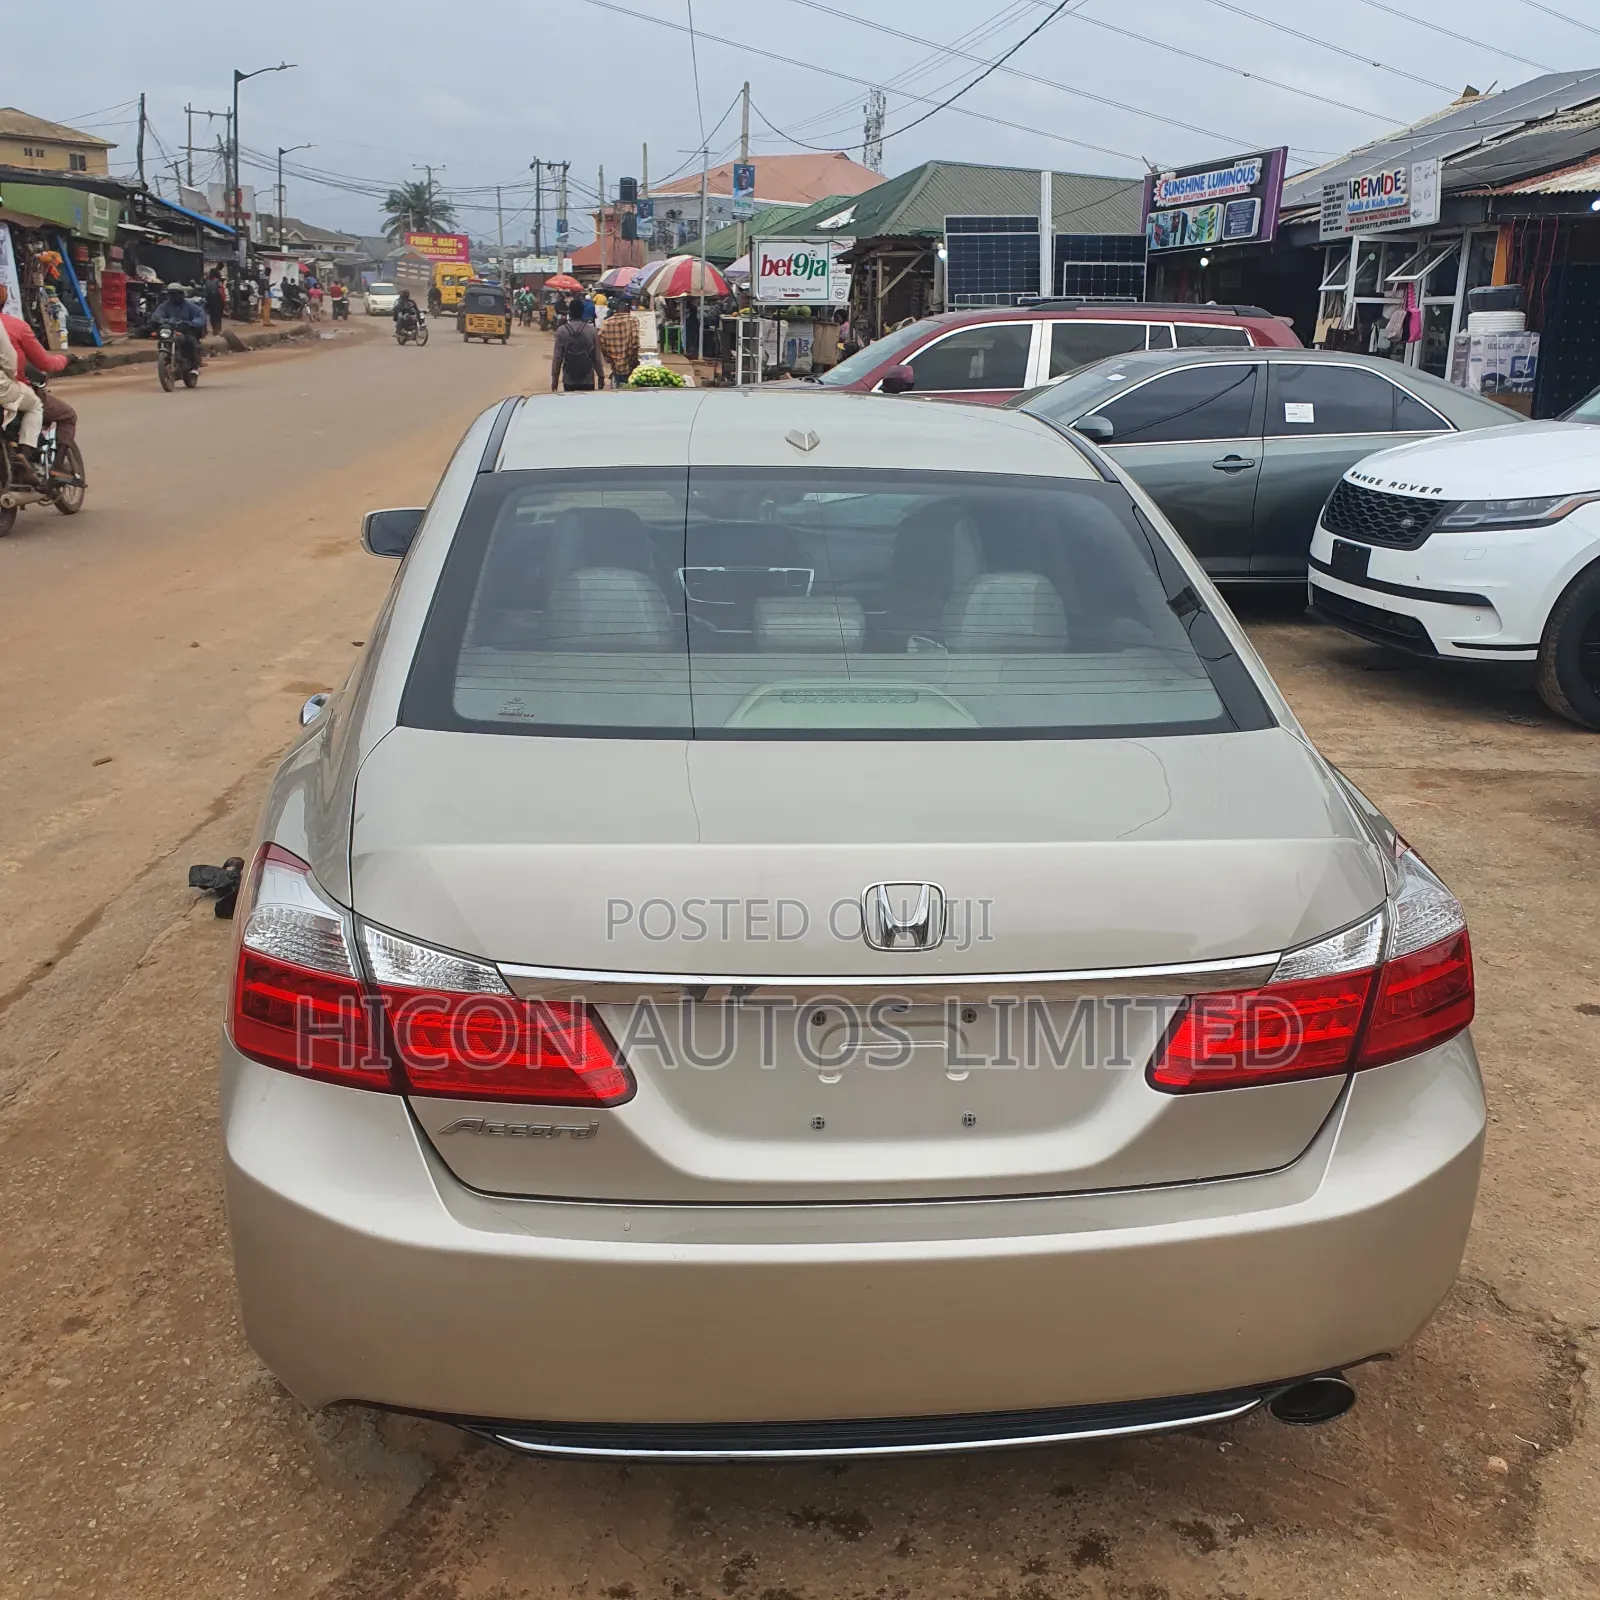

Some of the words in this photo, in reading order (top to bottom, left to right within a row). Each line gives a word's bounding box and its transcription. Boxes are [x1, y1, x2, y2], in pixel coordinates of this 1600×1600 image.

[1164, 175, 1205, 196] SUNSHINE
[1207, 166, 1256, 189] LUMINOUS
[1349, 170, 1402, 200] IREMIDE
[1183, 192, 1207, 201] SOLUTIONS
[1218, 188, 1236, 196] DESIGN
[1346, 200, 1364, 212] Adult
[1365, 200, 1370, 209] &
[1371, 197, 1386, 209] Kids
[1387, 196, 1404, 206] Store
[760, 252, 827, 280] bet9ja
[1350, 470, 1383, 486] RANGE
[1388, 481, 1442, 495] ROVER
[437, 1117, 600, 1141] Accord
